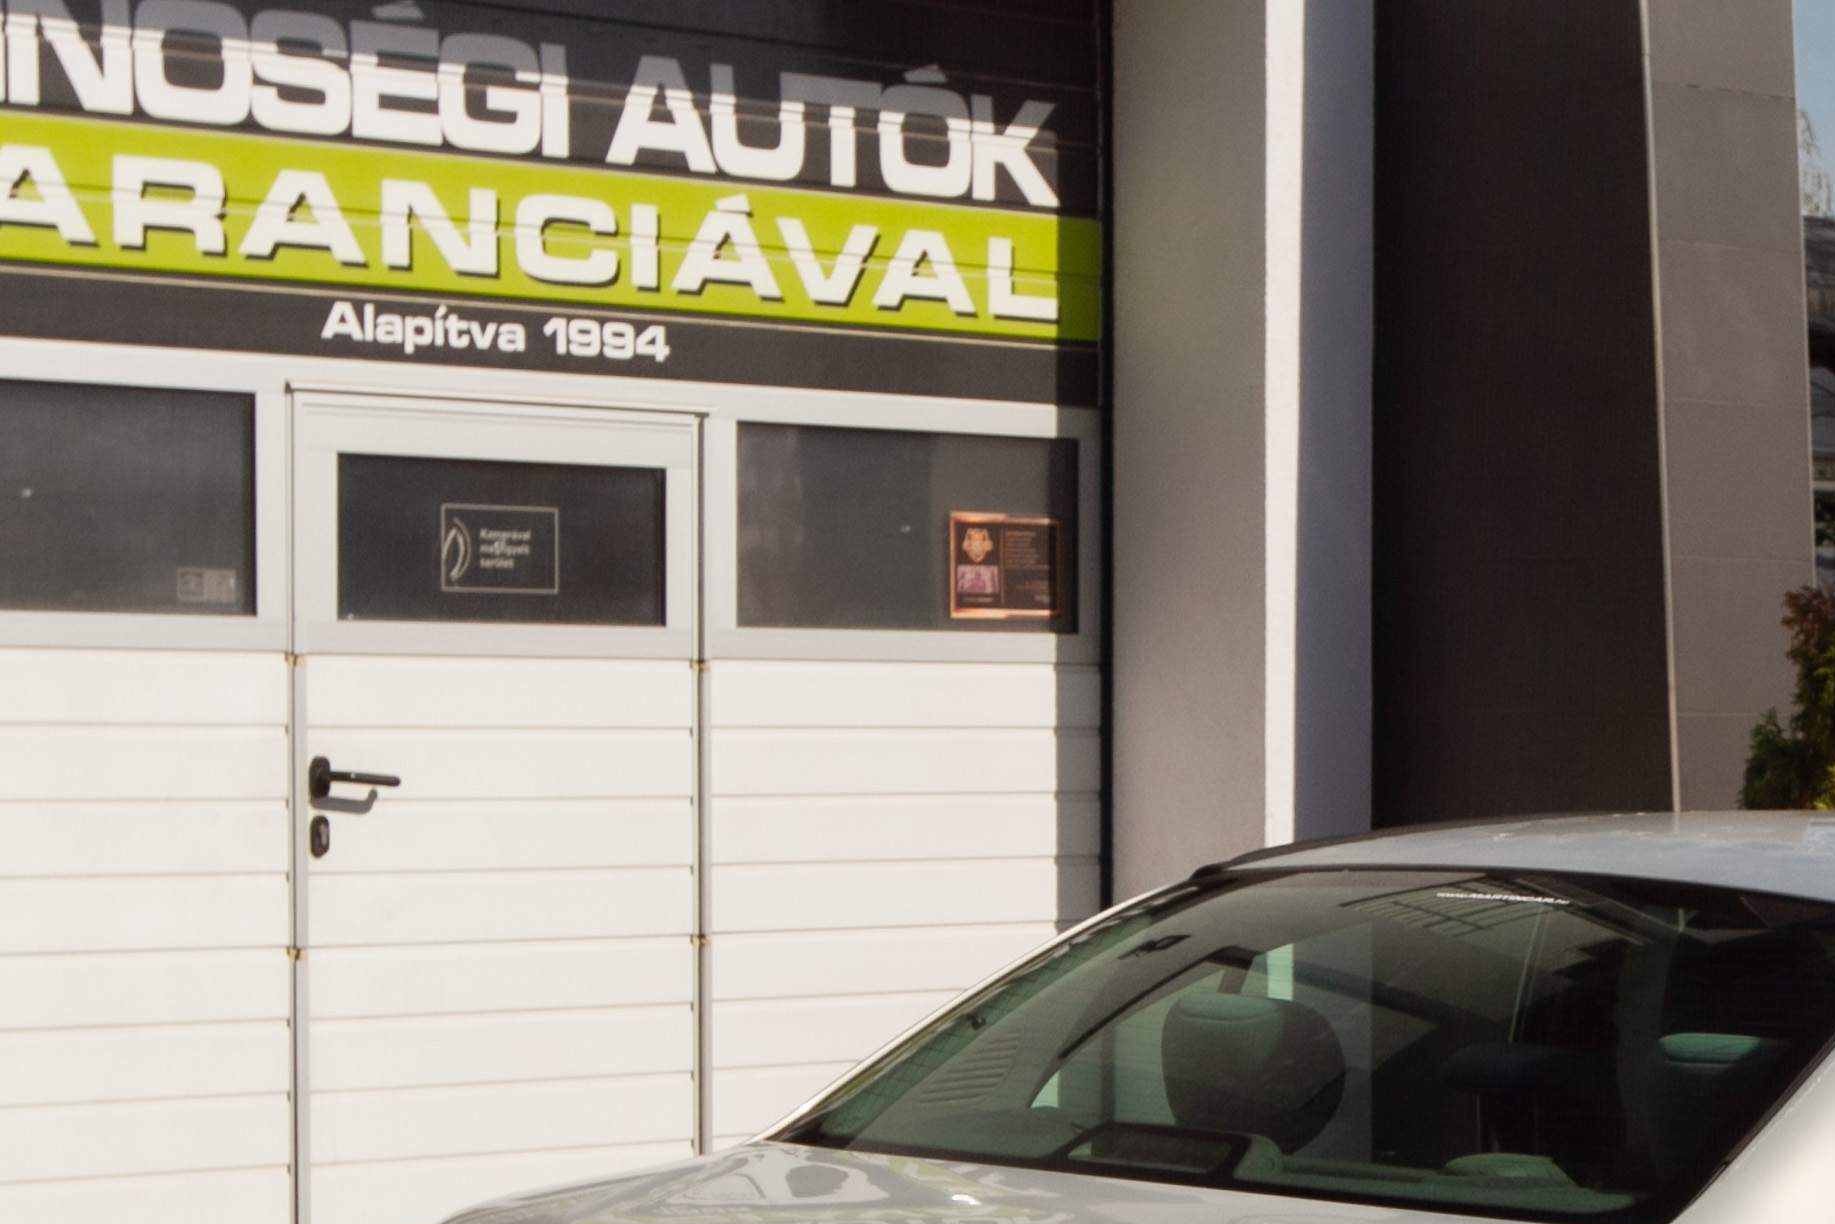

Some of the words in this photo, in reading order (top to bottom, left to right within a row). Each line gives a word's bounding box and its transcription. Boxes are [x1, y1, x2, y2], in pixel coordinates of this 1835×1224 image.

[606, 64, 1060, 208] AUTÓK
[321, 301, 526, 355] Alapítva
[543, 316, 670, 363] 1994
